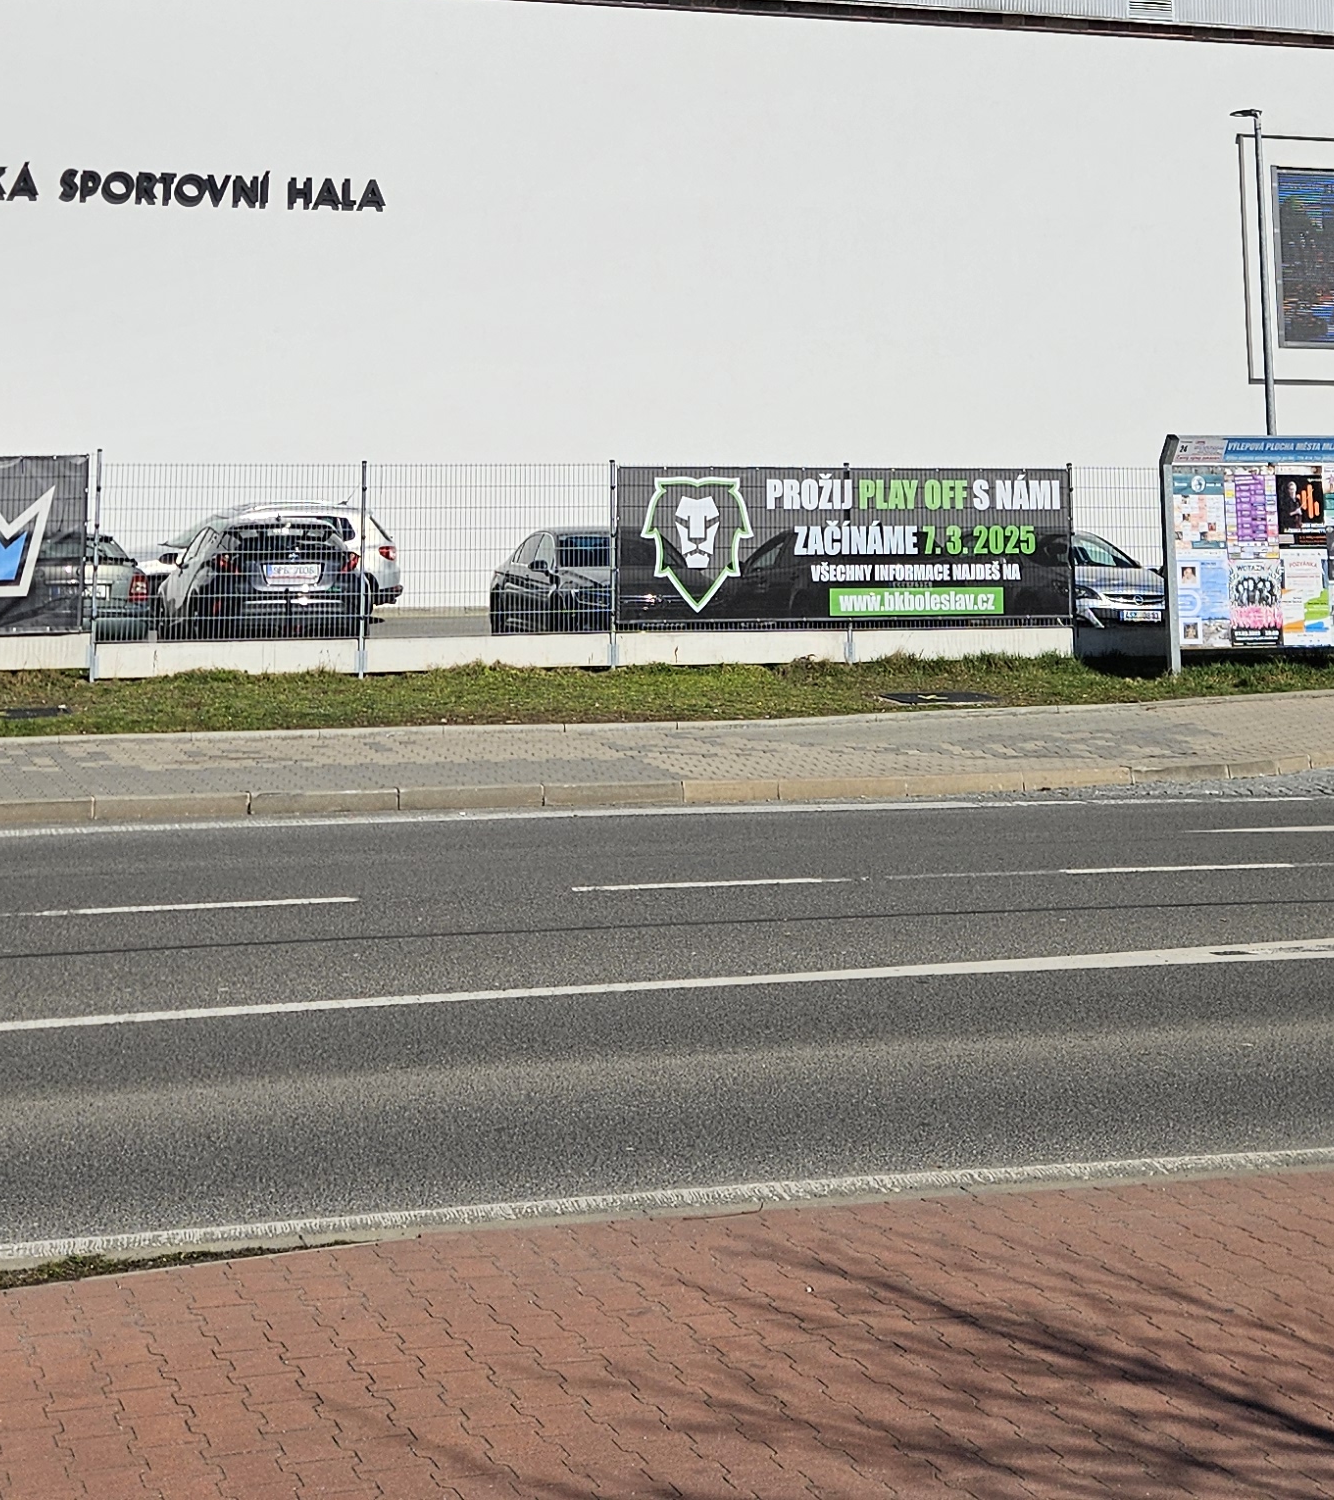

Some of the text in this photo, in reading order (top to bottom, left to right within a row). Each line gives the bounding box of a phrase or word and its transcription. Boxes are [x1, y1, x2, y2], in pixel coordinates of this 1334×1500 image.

[58, 168, 271, 209] SPORTOVNÍ
[287, 176, 387, 212] HALA
[1265, 441, 1294, 451] PLOCHA
[766, 473, 1061, 511] PROŽIJ PLAY OFF S NÁMI
[793, 520, 1037, 556] ZAČÍNÁME 7. 3. 2025
[810, 560, 1022, 583] VŠECHNY INFORMACE NAJDEŠ NA
[838, 590, 996, 612] www.bkboleslav.cz
